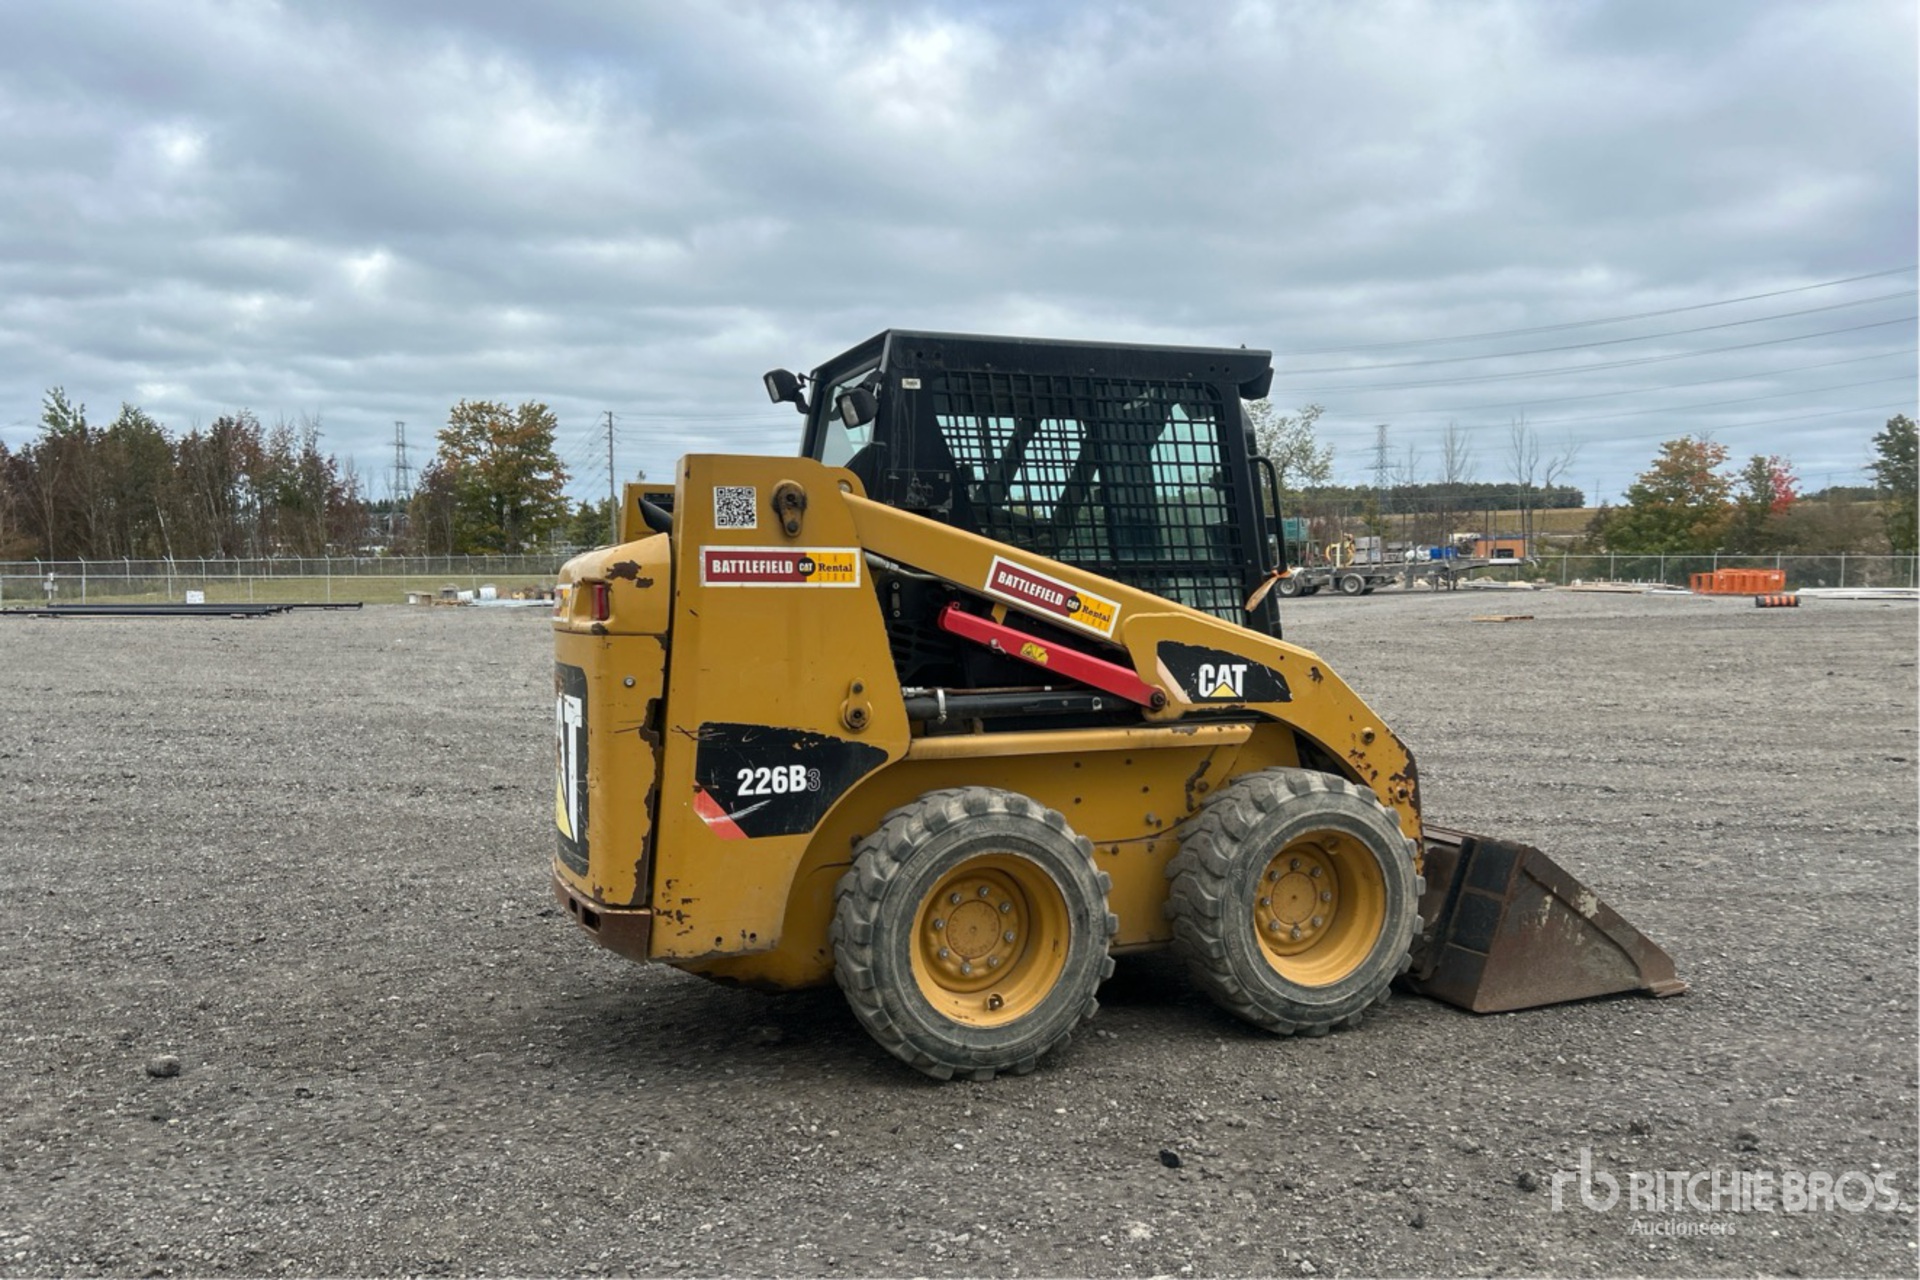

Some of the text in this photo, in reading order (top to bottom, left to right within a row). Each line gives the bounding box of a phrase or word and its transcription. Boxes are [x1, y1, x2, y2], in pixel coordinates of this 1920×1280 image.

[712, 559, 853, 574] BATTLEFIELD CAT Rental
[997, 570, 1064, 606] BATTLEFIELD
[1082, 604, 1111, 622] Rental
[1198, 663, 1248, 698] CAT
